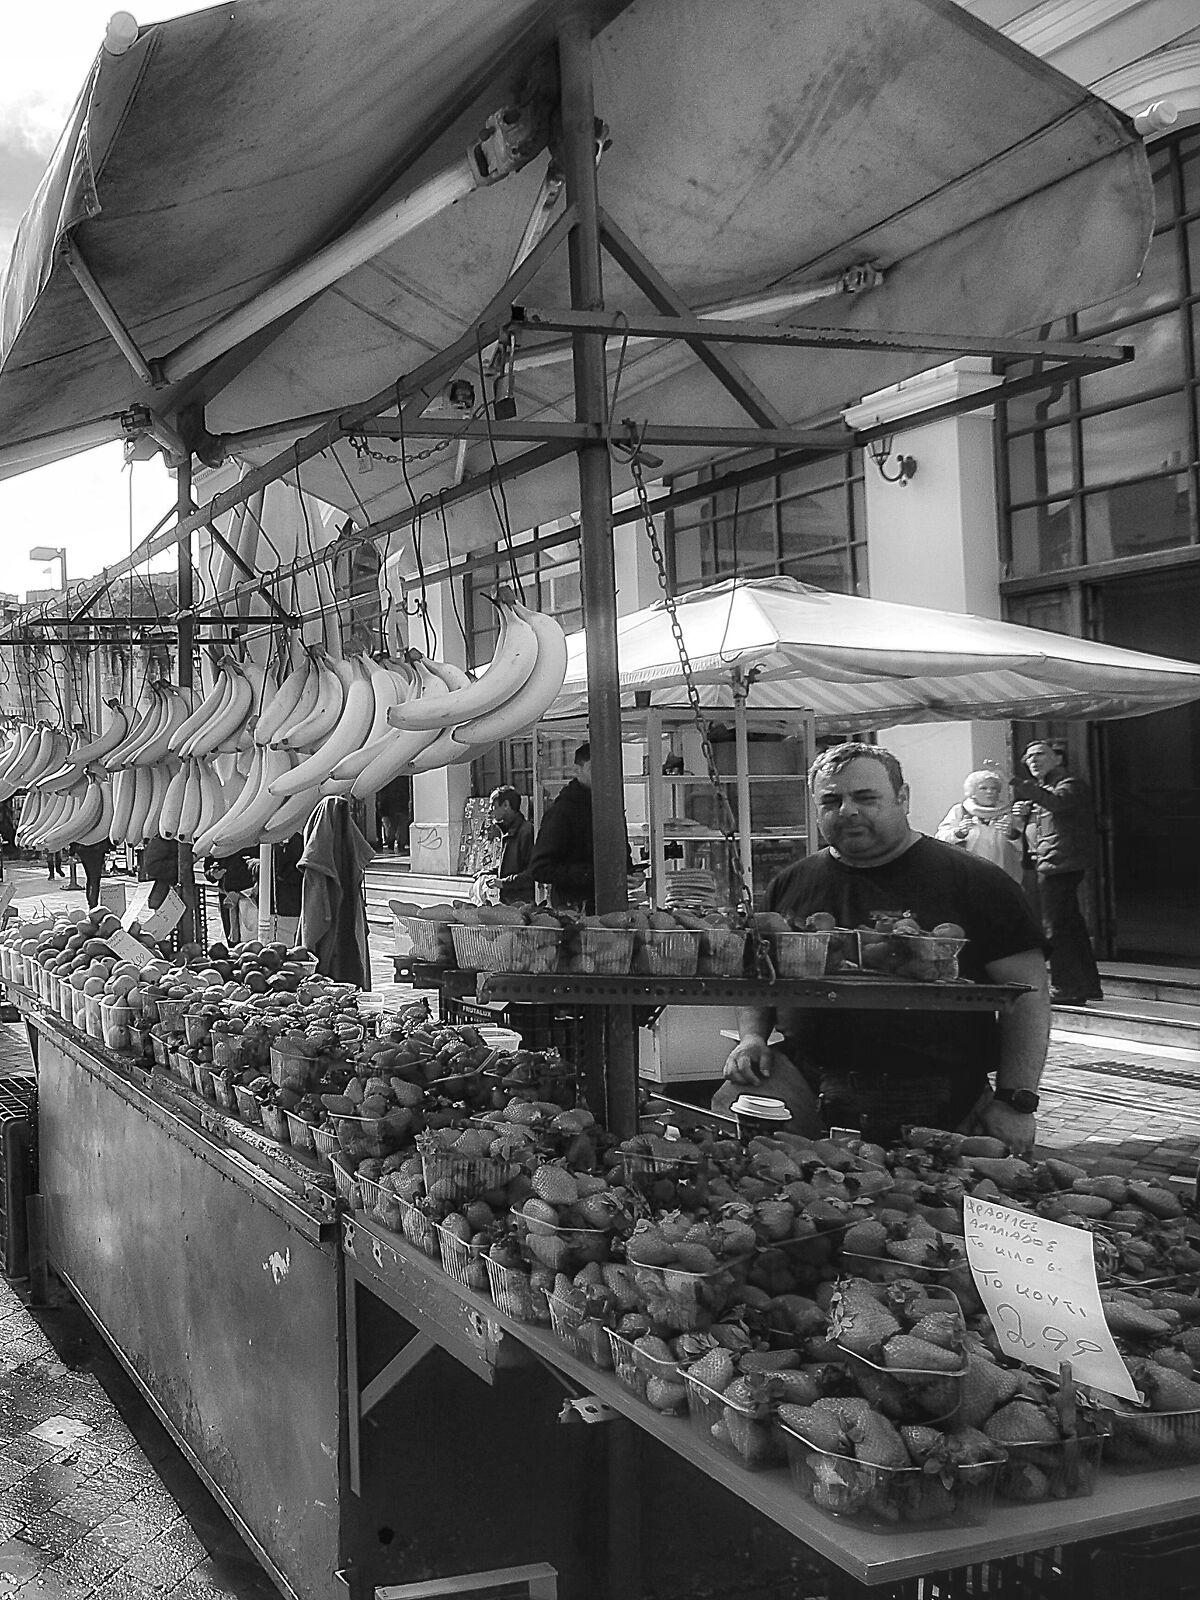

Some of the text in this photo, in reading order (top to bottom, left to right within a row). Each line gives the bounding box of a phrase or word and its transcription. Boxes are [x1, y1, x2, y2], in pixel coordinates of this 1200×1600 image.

[462, 1005, 492, 1018] FRUTALUX
[1016, 1284, 1087, 1318] ΚΟΥΤΙ
[996, 1303, 1104, 1358] 2.99
